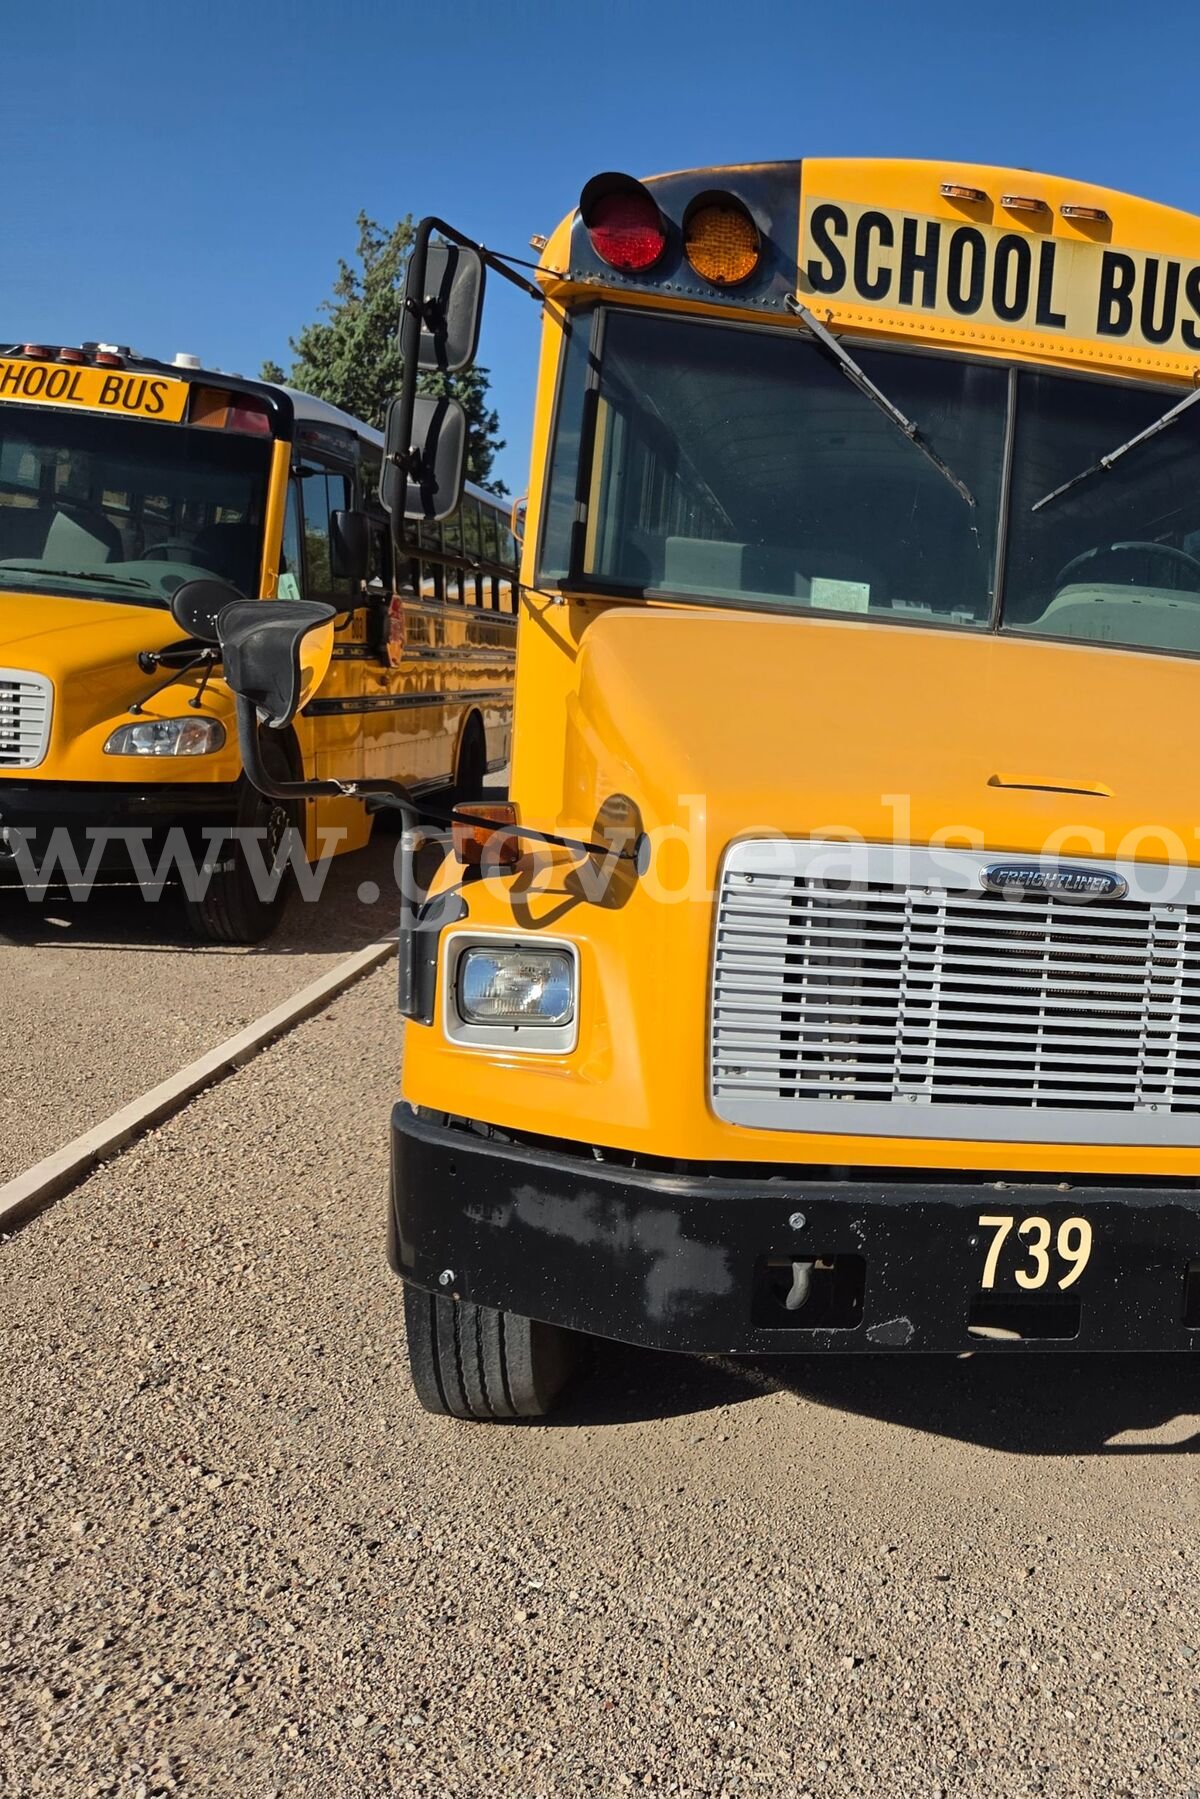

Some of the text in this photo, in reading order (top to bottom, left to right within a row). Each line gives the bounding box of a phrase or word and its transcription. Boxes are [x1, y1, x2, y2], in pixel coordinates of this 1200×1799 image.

[797, 203, 1066, 330] SCHOOL
[0, 363, 168, 413] HOOL BUS
[996, 870, 1111, 892] FREIGHTLINER
[978, 1215, 1092, 1290] 739
